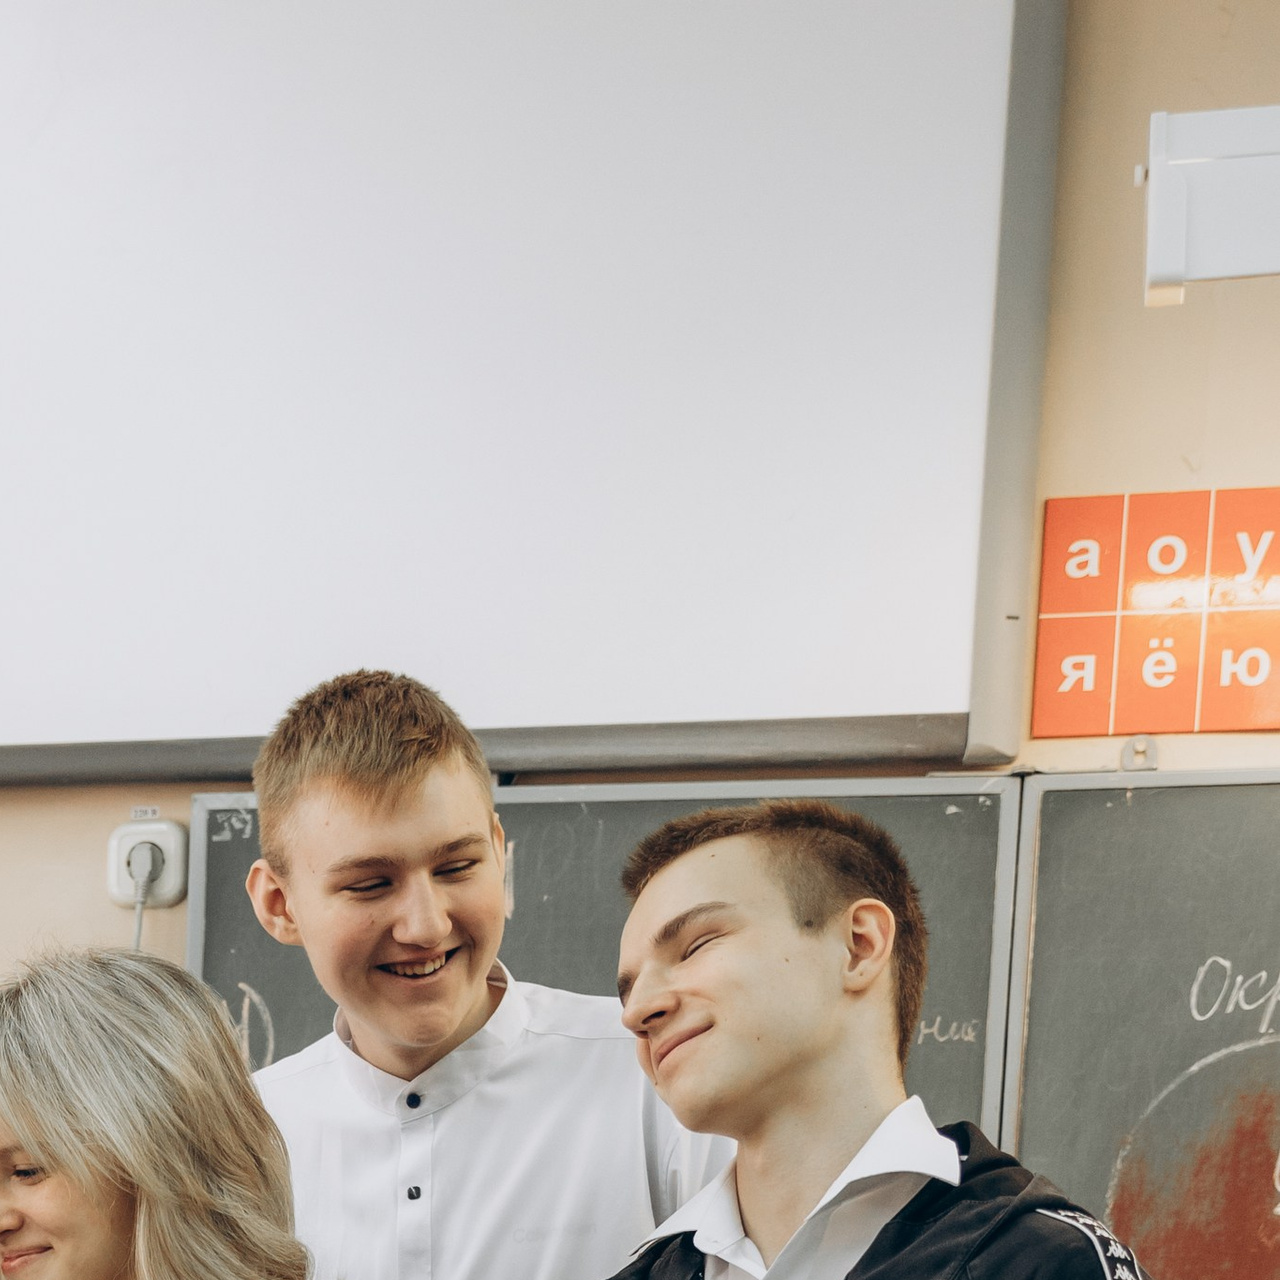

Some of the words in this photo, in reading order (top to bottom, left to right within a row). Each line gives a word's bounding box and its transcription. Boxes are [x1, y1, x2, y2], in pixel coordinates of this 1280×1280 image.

[1064, 539, 1102, 579] а
[1147, 535, 1188, 575] о
[1236, 530, 1275, 582] у
[1057, 654, 1097, 693] я
[1141, 637, 1178, 688] ё
[1219, 648, 1271, 687] ю
